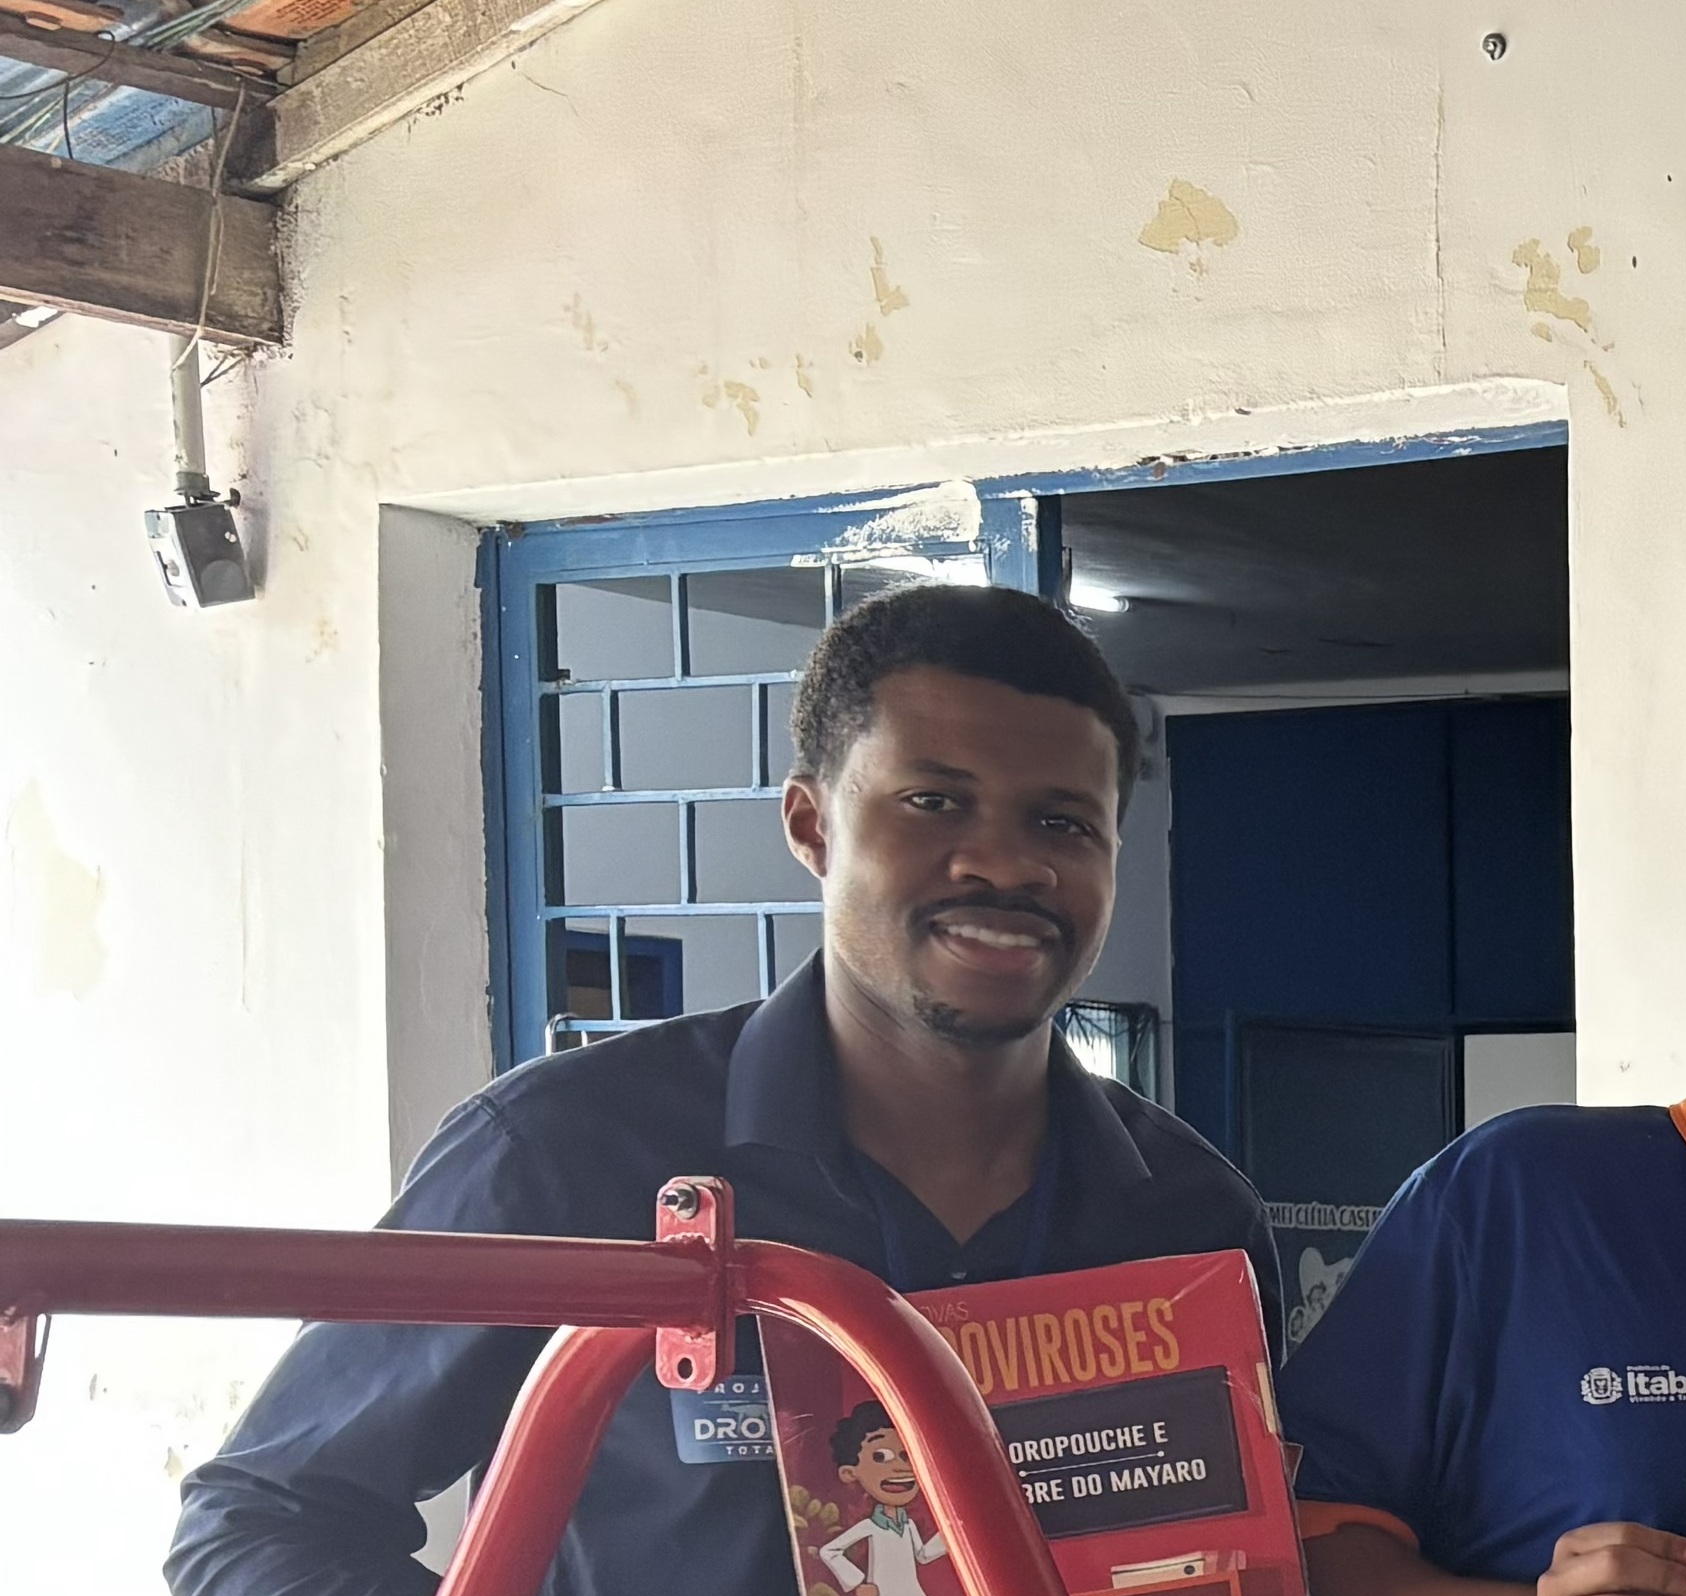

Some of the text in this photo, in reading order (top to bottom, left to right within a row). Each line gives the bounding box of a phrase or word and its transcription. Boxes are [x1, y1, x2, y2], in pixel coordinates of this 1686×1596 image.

[938, 1297, 1181, 1396] OVIROSES
[694, 1418, 766, 1441] DRO
[1008, 1421, 1169, 1465] OROPOUCHE E
[1072, 1458, 1207, 1496] DO MAYARO
